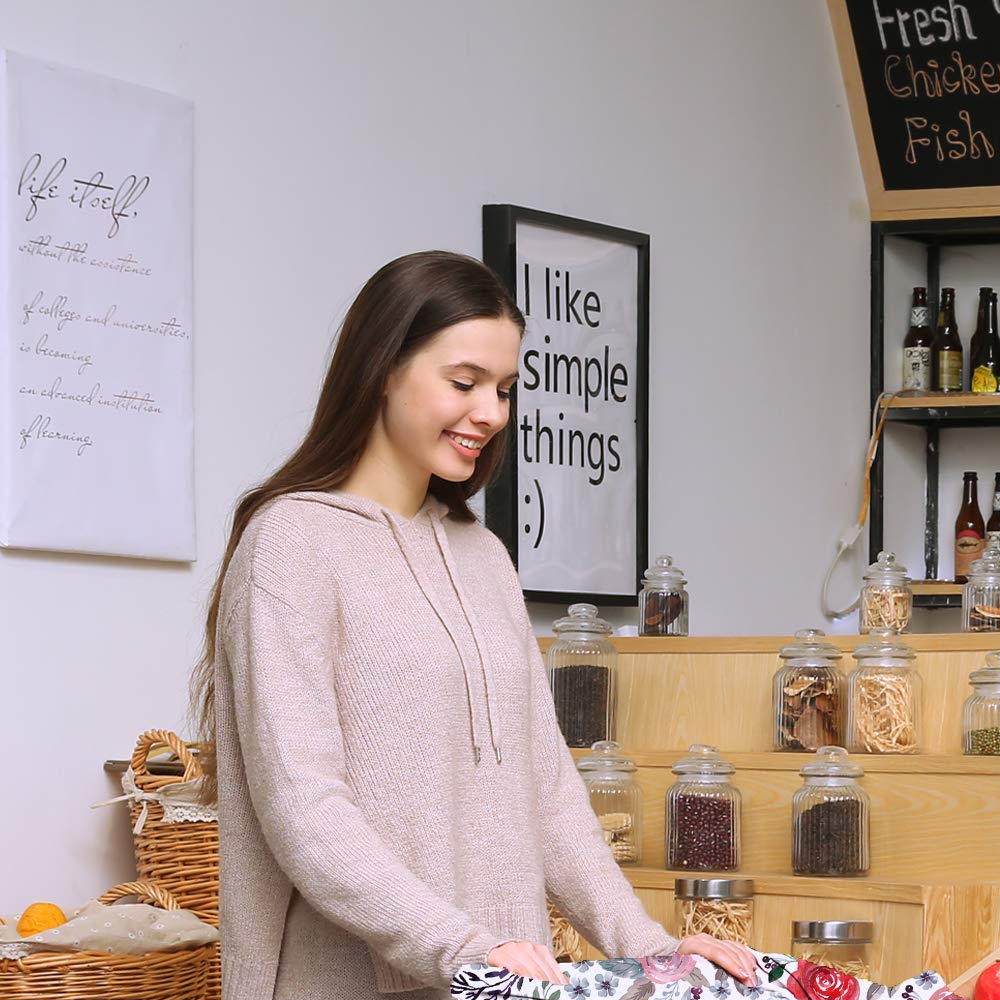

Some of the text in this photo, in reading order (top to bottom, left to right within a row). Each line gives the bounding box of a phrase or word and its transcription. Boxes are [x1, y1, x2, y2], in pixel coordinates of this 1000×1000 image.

[905, 110, 995, 164] Fish
[523, 263, 601, 328] I like
[523, 335, 628, 413] simple
[520, 408, 620, 485] things
